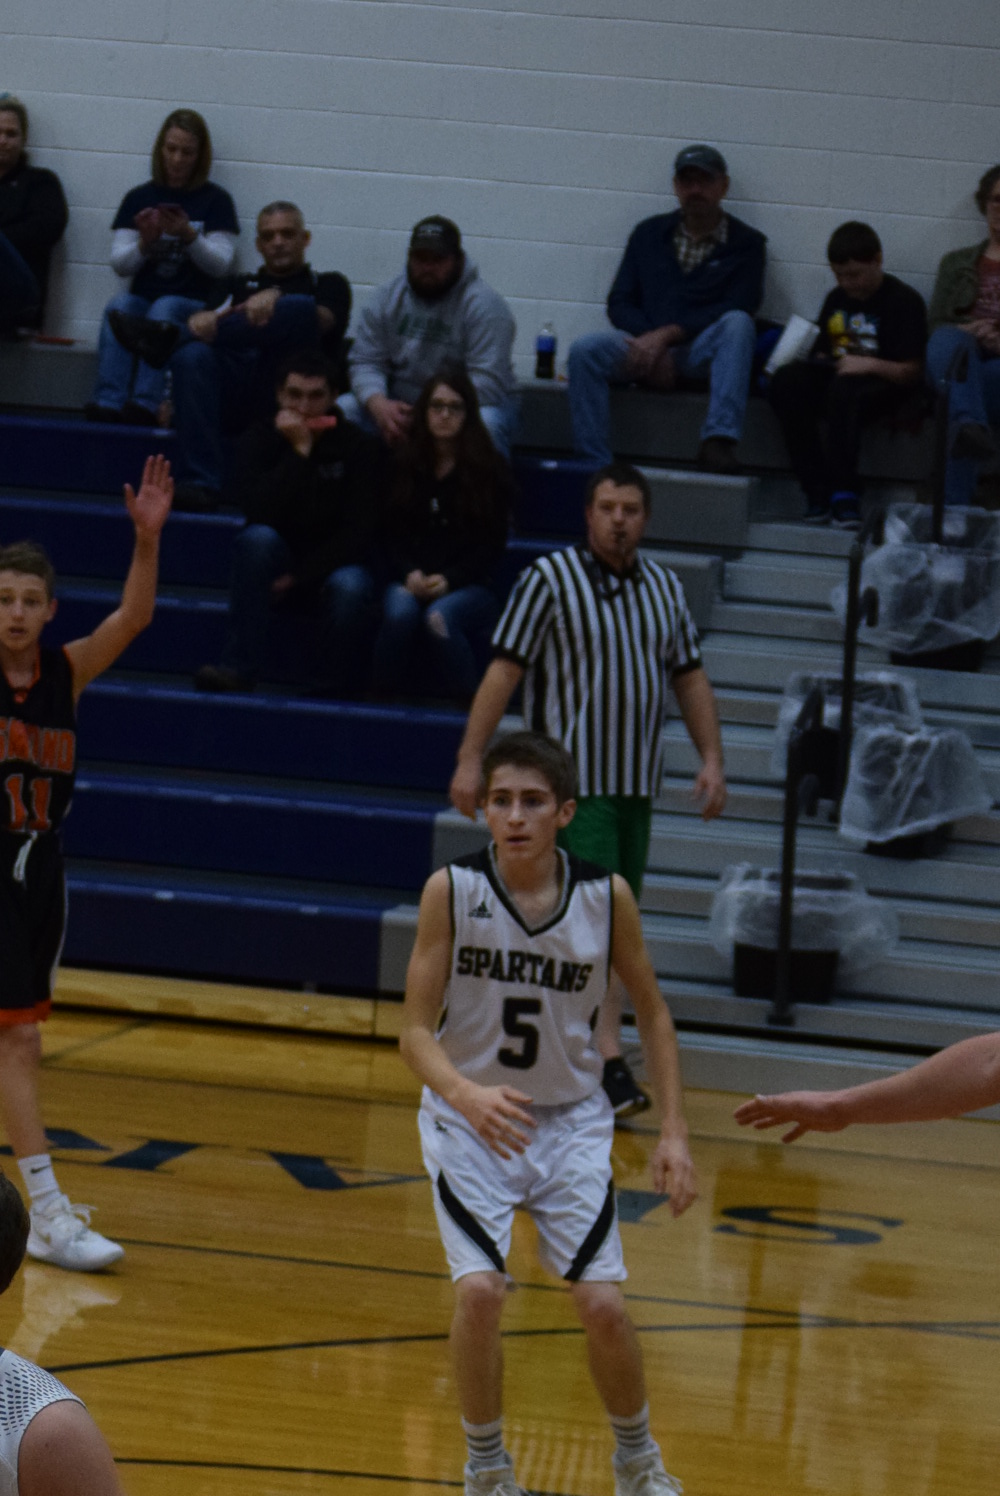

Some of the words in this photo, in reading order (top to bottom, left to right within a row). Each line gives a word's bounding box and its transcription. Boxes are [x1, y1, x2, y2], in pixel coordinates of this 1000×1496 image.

[4, 773, 53, 834] 11
[457, 946, 593, 993] SPARTANS
[498, 997, 542, 1070] 5
